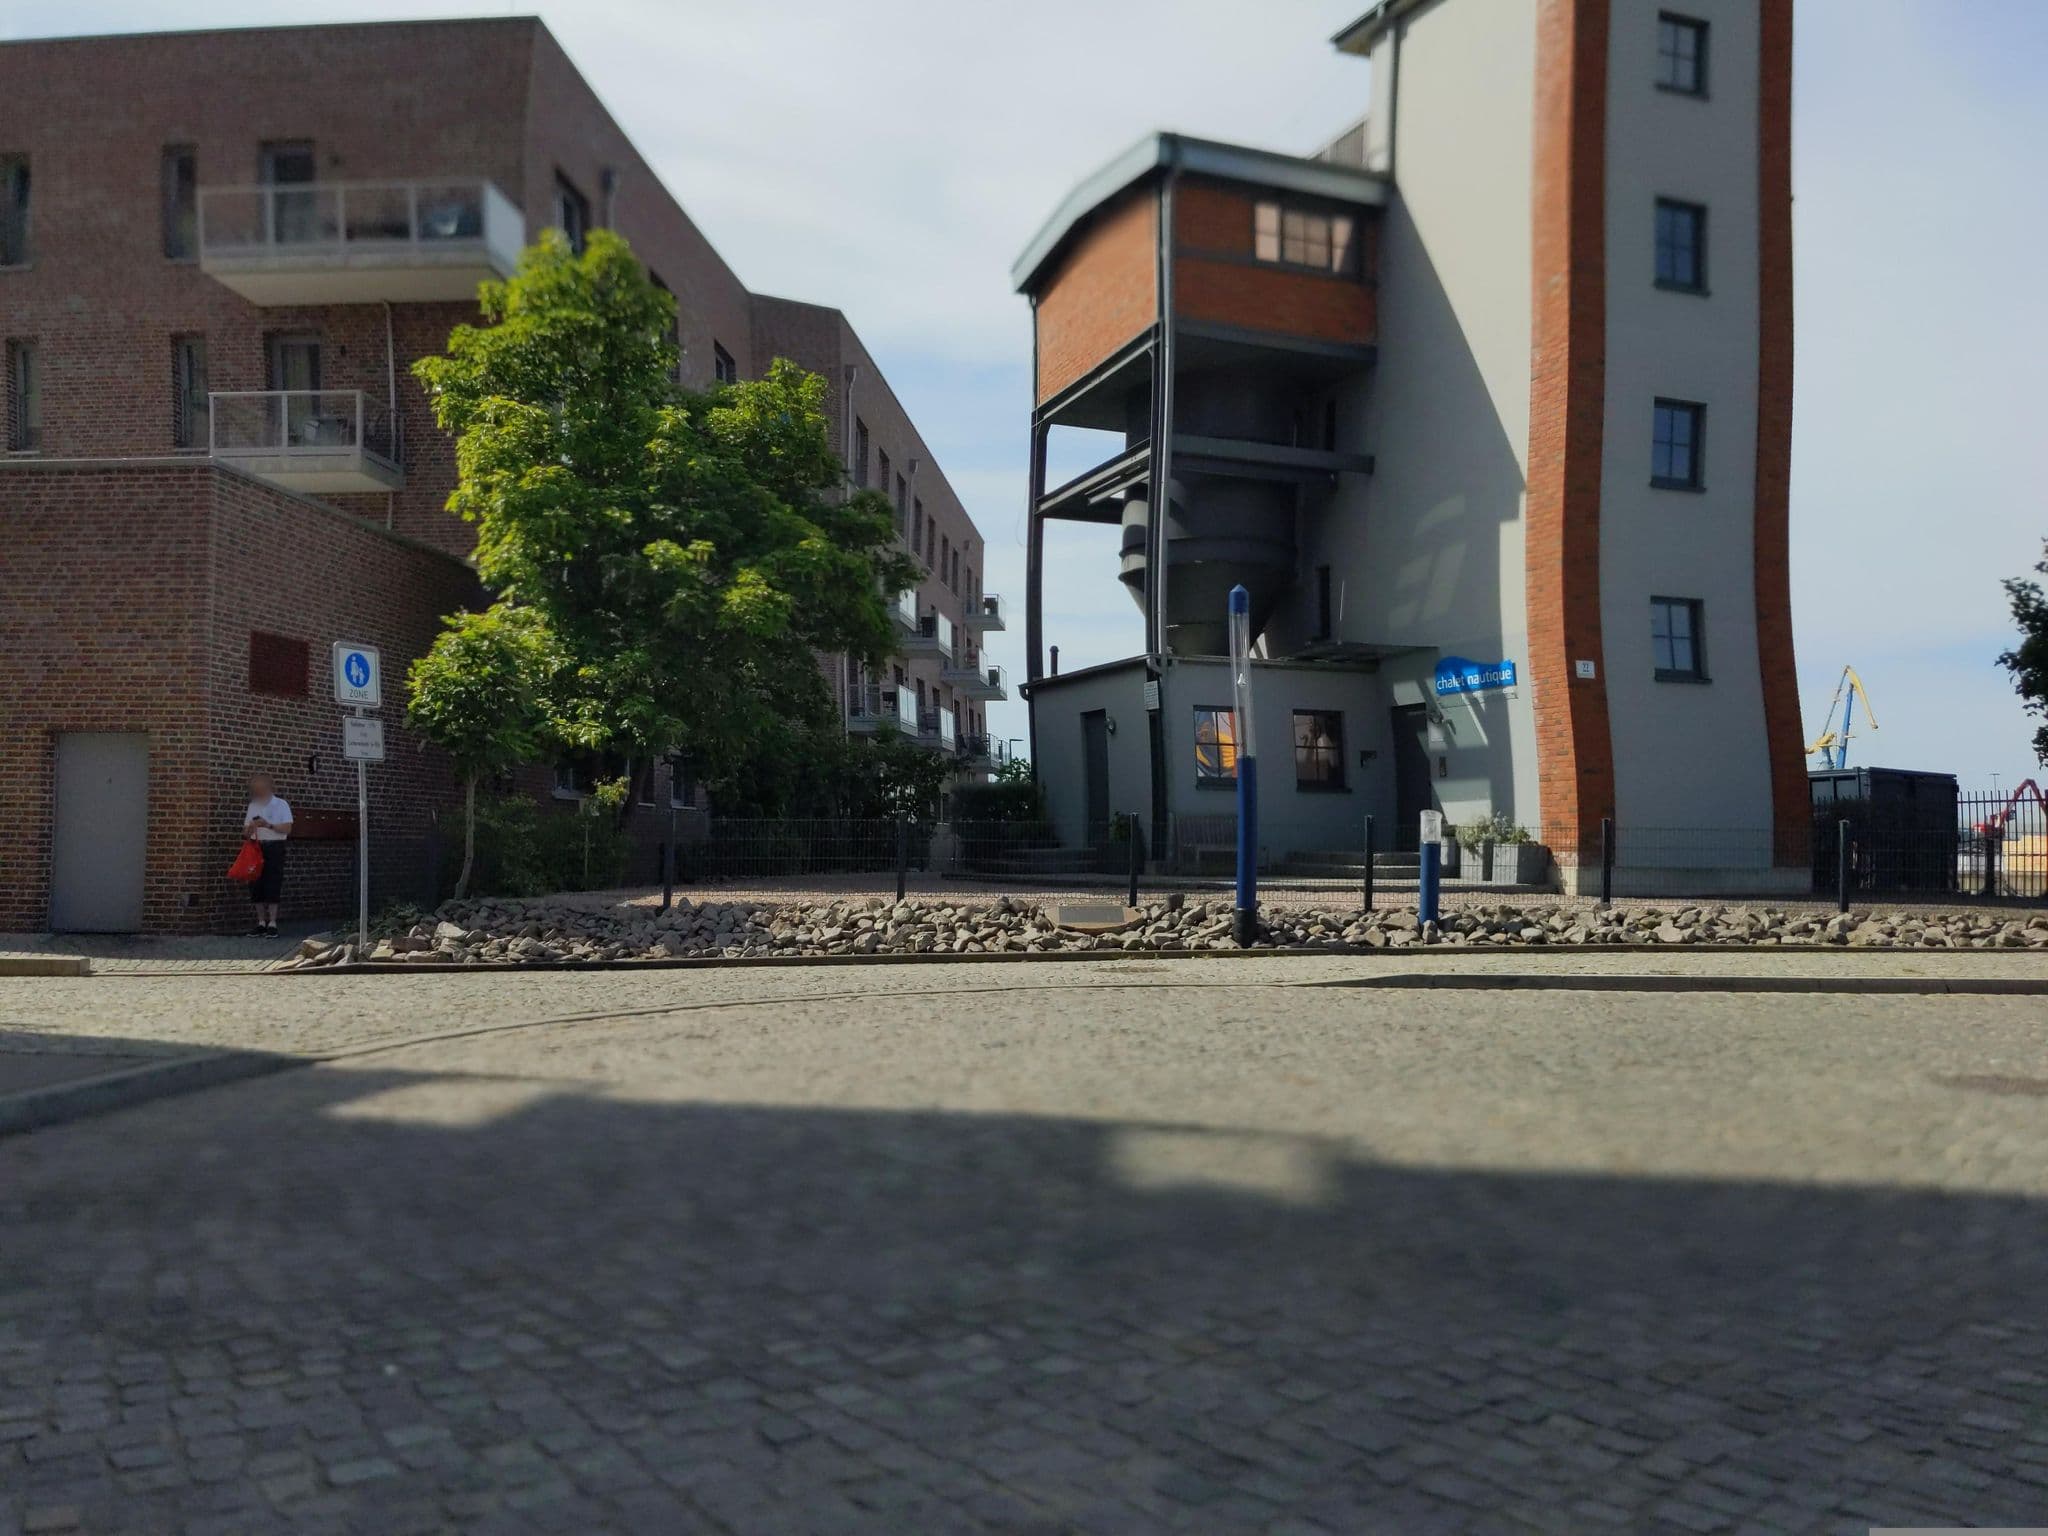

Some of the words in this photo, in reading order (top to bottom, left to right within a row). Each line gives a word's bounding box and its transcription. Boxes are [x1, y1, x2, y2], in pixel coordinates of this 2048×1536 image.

[1436, 675, 1465, 690] chalet
[1466, 669, 1512, 685] nautique
[349, 689, 369, 699] ZONE
